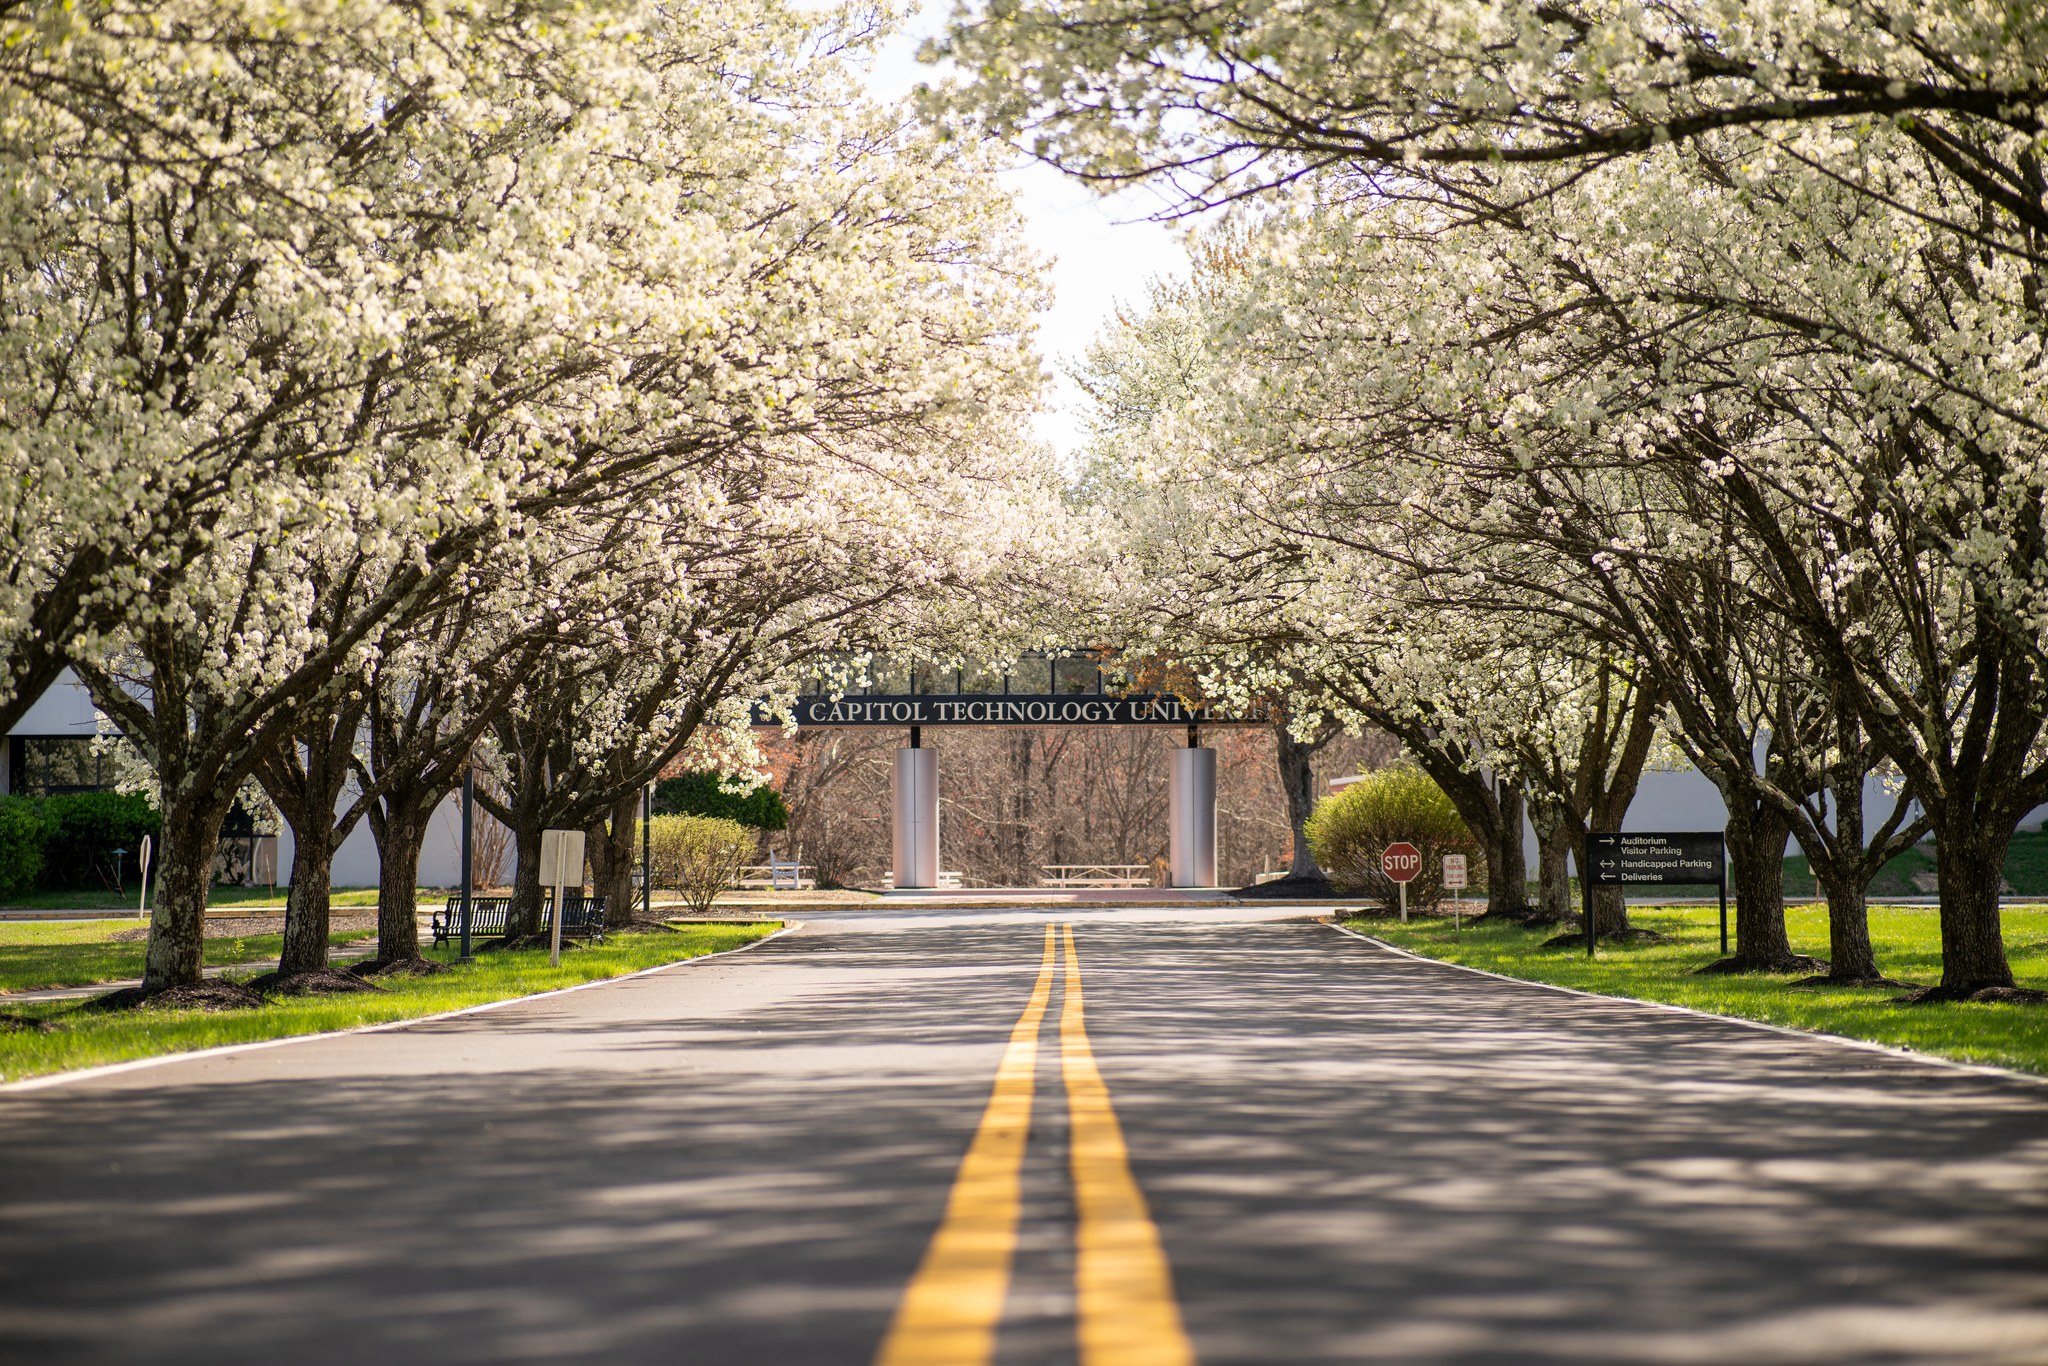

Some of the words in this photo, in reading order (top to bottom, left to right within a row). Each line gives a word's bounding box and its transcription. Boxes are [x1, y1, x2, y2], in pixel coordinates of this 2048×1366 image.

[809, 702, 927, 721] CAPITOL
[933, 702, 1121, 721] TECHNOLOGY
[1620, 837, 1667, 845] Auditorium
[1621, 847, 1647, 855] Visitor
[1650, 847, 1682, 856] Parking
[1384, 855, 1419, 870] STOP
[1621, 860, 1677, 869] Handicapped
[1680, 860, 1712, 869] Parking
[1621, 873, 1663, 881] Deliveries
